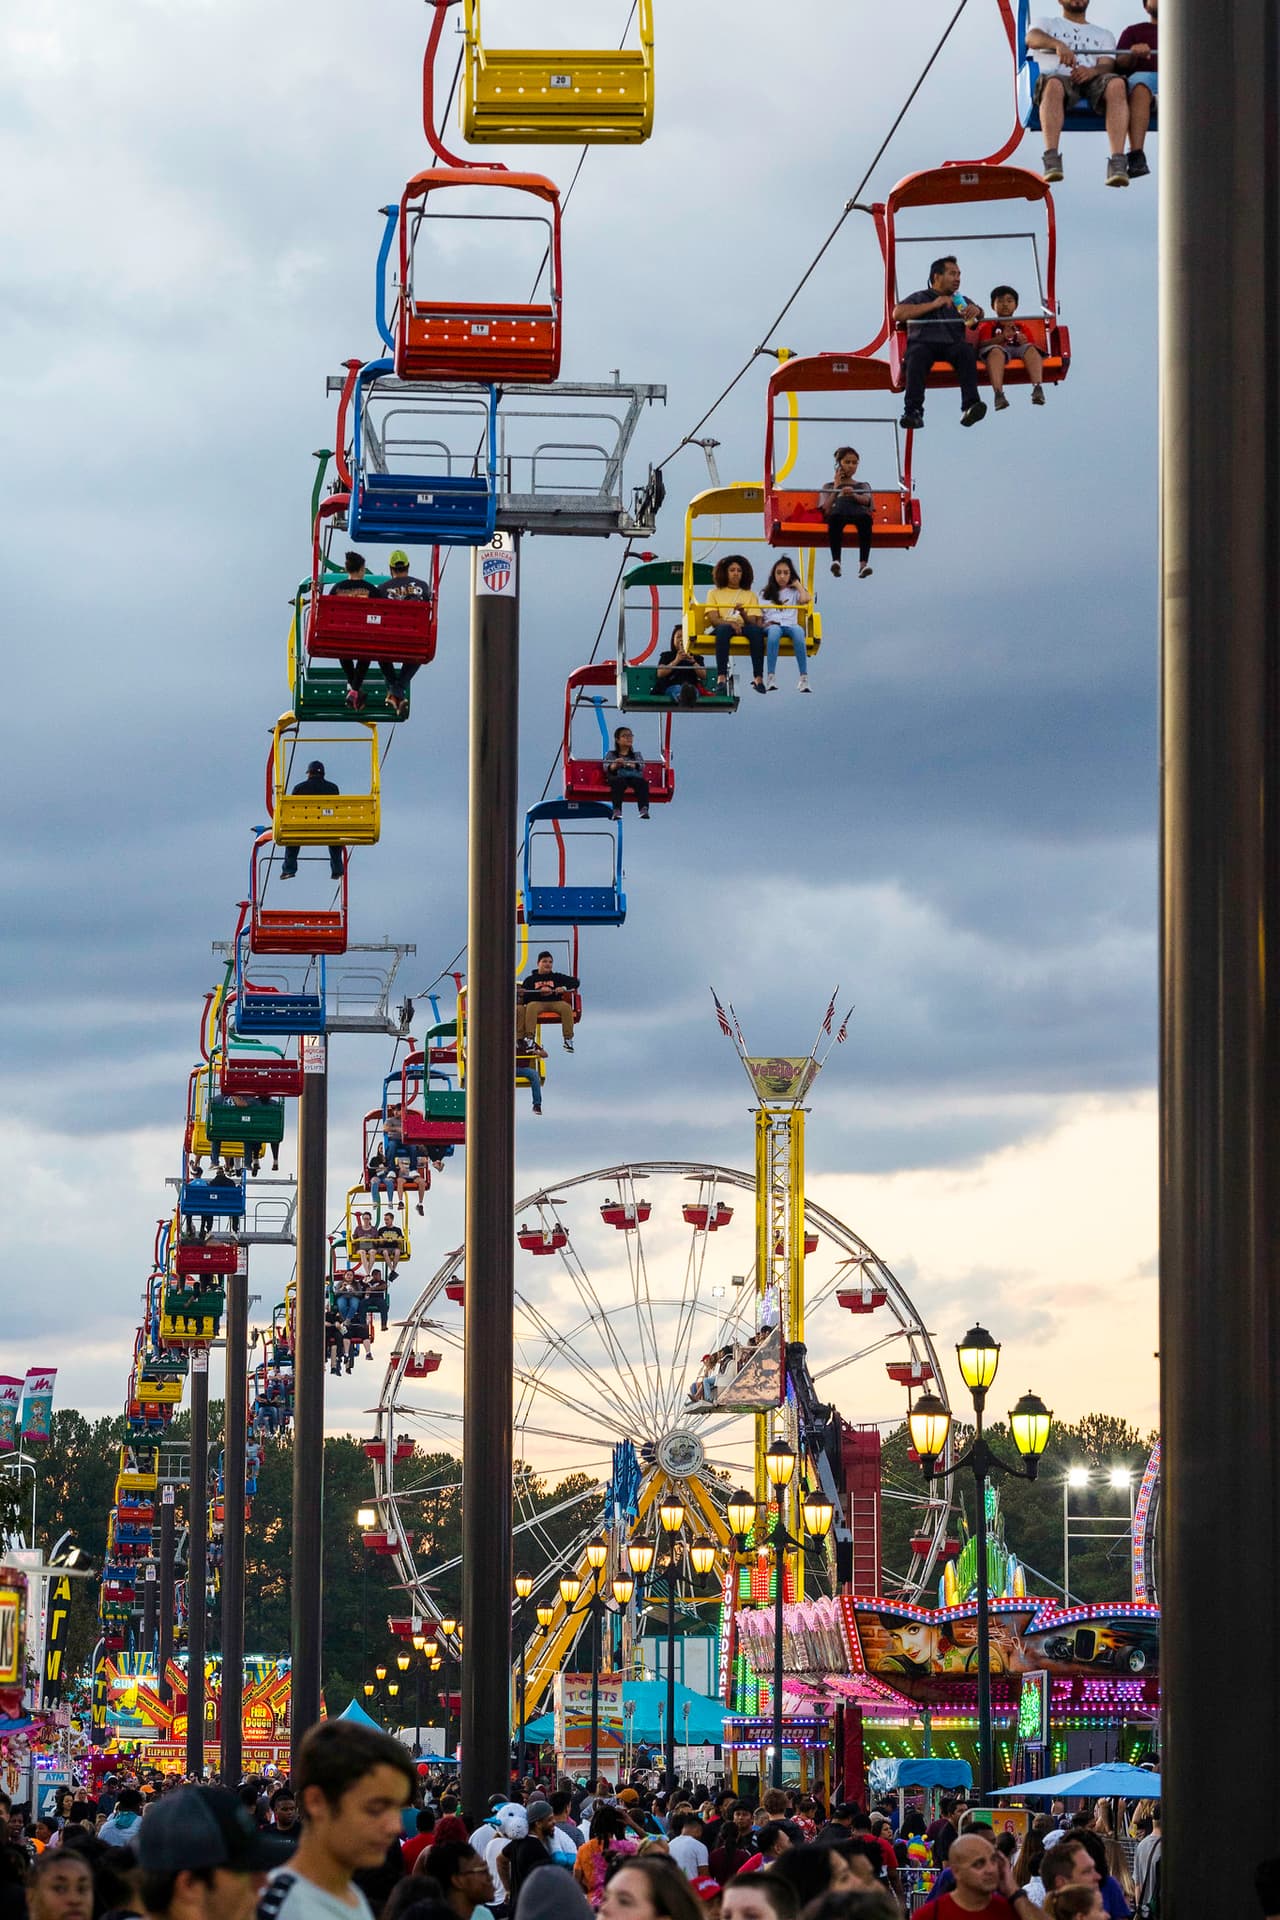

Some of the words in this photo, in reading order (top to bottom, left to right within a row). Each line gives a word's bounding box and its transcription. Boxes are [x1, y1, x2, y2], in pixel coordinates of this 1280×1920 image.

[556, 76, 566, 84] 20
[481, 551, 513, 562] AMERICAN
[752, 1063, 803, 1079] Vertigo
[91, 1656, 107, 1723] ATM
[246, 1717, 271, 1728] DOUGH
[147, 1747, 176, 1757] ELEPHANT
[254, 1750, 270, 1758] CAKES
[46, 1773, 65, 1781] ATM
